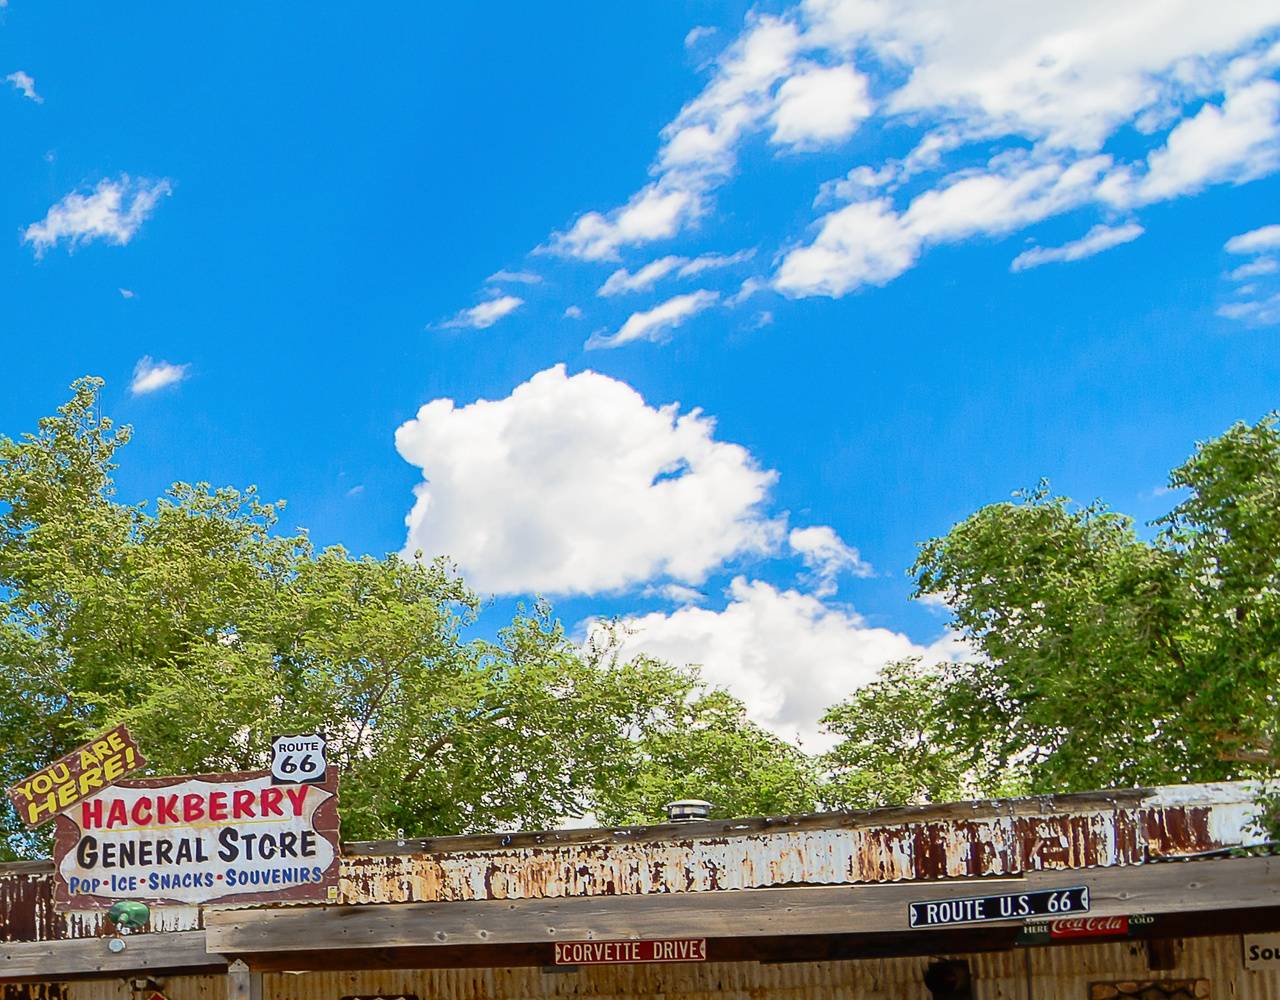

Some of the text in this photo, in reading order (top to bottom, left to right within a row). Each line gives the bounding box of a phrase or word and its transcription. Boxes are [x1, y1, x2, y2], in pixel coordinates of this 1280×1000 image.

[278, 741, 320, 754] ROUTE
[18, 731, 127, 801] YOU ARE
[280, 754, 317, 775] 66
[28, 748, 137, 824] HERE!
[81, 784, 310, 830] HACKBERRY
[76, 826, 317, 870] GENERAL STORE
[68, 866, 323, 895] POP ICE SNACKS SOUVENIRS
[926, 891, 1072, 924] ROUTE U.S. 66
[1128, 915, 1155, 926] COLD
[1023, 924, 1049, 935] HERE
[562, 940, 699, 962] CORVETTE DRIVE
